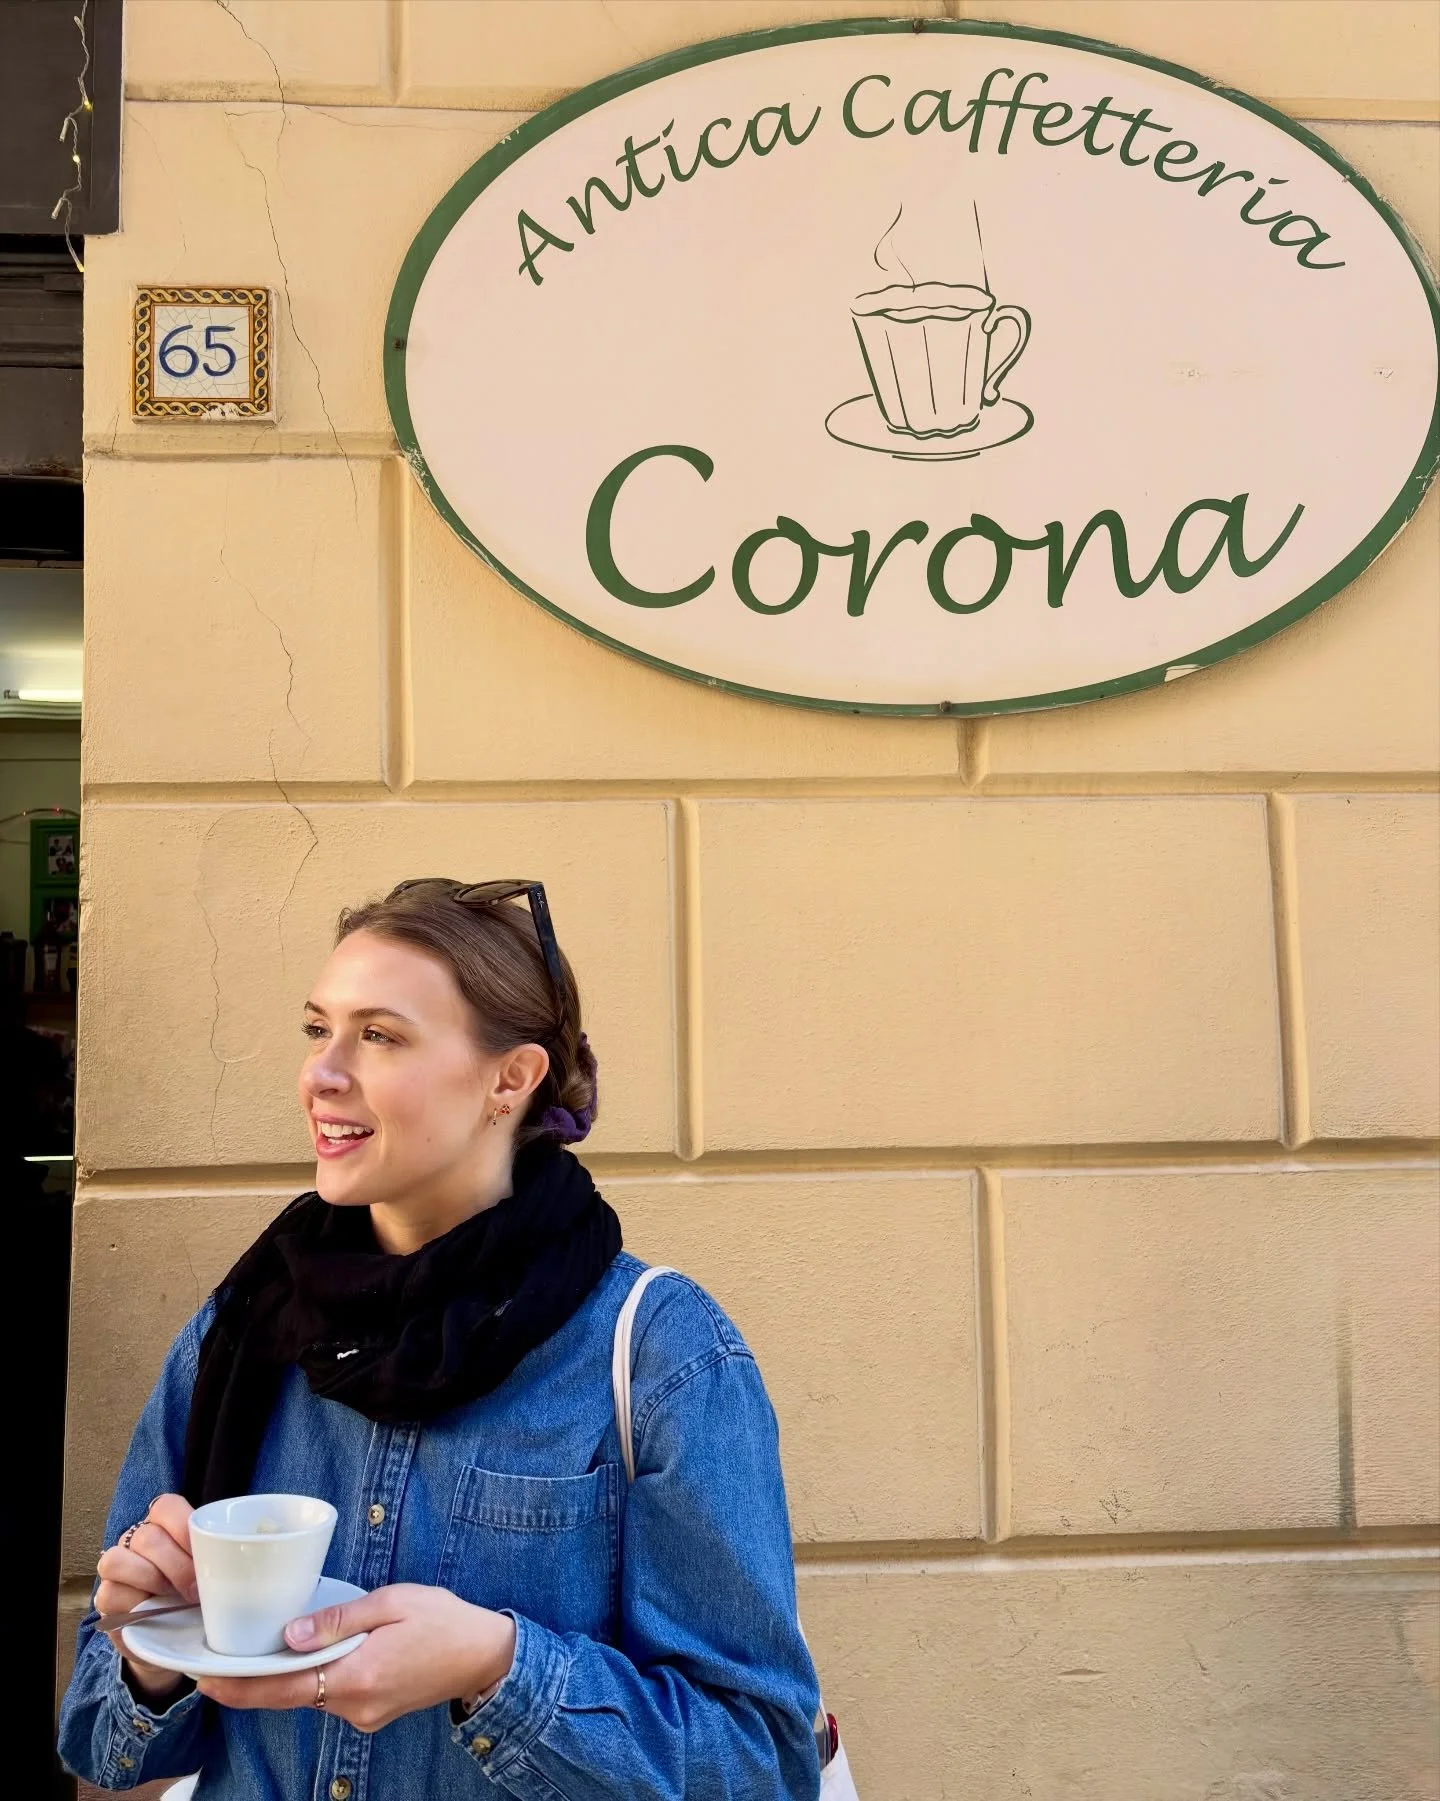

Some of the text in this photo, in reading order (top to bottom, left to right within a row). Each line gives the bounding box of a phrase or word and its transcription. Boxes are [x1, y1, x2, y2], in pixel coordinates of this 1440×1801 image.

[517, 67, 1346, 286] Antica Caffetteria
[159, 325, 236, 378] 65
[585, 444, 1306, 617] Corona
